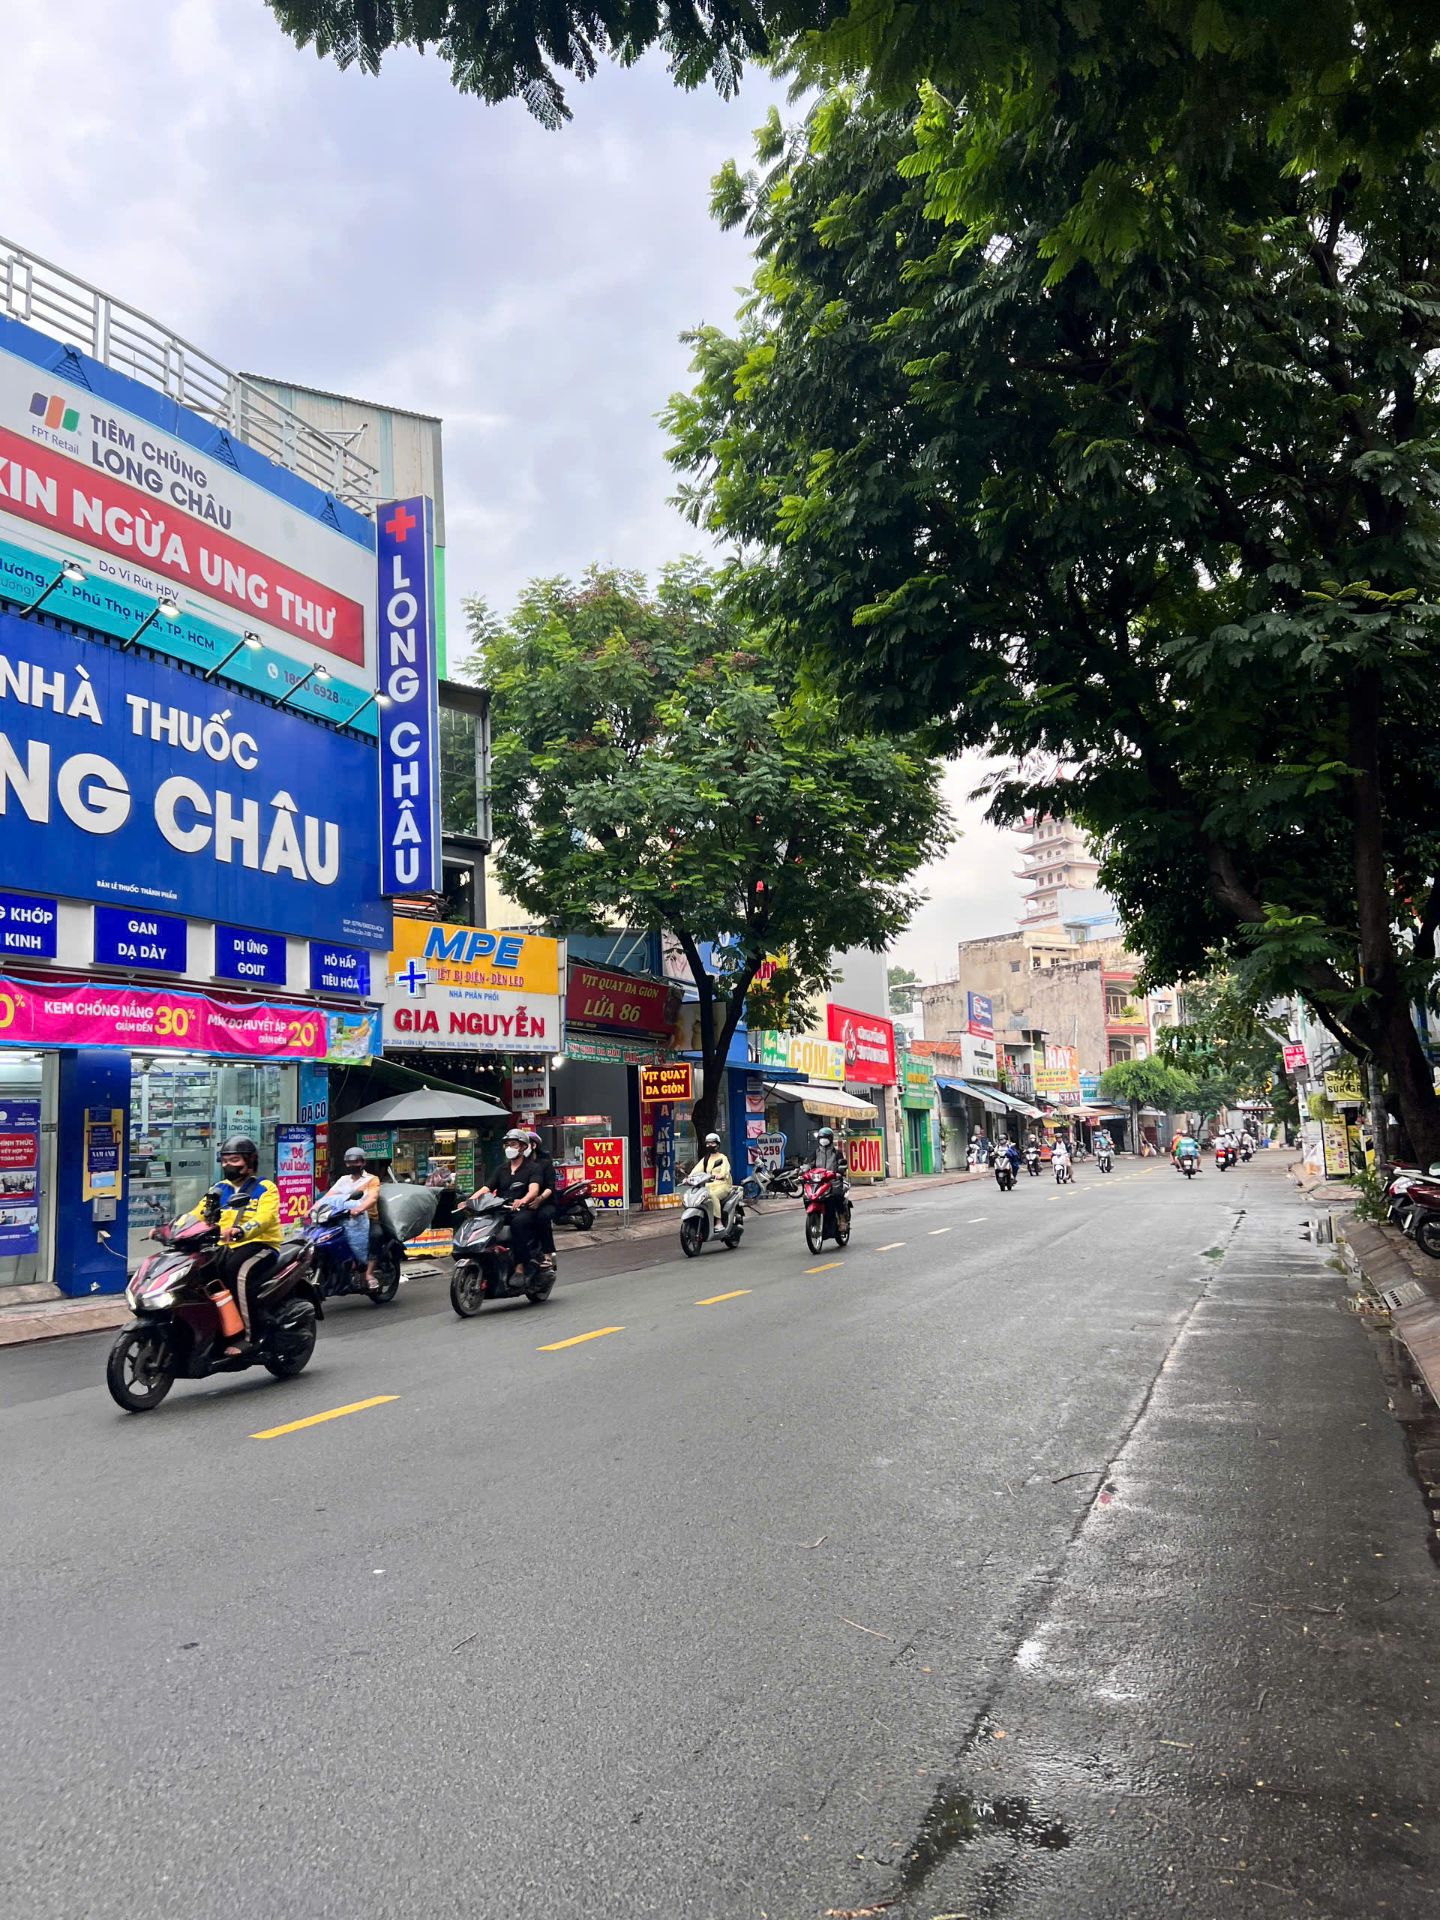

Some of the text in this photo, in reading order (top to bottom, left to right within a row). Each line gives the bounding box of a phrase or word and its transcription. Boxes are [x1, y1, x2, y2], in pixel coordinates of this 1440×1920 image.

[31, 424, 79, 455] FPT Retail
[90, 413, 208, 489] TIÊM CHỦNG
[92, 440, 232, 530] LONG CHÂU
[73, 488, 190, 574] NGỪA
[200, 546, 268, 609] UNG
[275, 585, 336, 640] THƯ
[99, 560, 116, 576] Do
[134, 574, 152, 590] Rút
[156, 583, 179, 600] HPV
[0, 557, 47, 588] ương,
[72, 586, 101, 607] Phú
[104, 597, 131, 621] Thọ
[135, 608, 163, 632] Ha,
[166, 620, 185, 640] TP.
[188, 630, 215, 651] HCM
[386, 554, 420, 703] LONG
[313, 681, 339, 704] 6928
[0, 654, 259, 770] NHÀ THUỐC
[0, 731, 340, 886] NG CHÂU
[389, 721, 422, 884] CHÂU
[118, 883, 139, 893] THUỐC
[11, 907, 53, 925] KHỚP
[128, 920, 158, 935] GAN
[5, 933, 41, 949] KINH
[234, 938, 268, 955] DỊ ỨNG
[423, 925, 525, 969] MPE
[118, 943, 166, 960] DẠ DÀY
[238, 963, 265, 976] GOUT
[324, 954, 356, 969] HÔ HẤP
[322, 974, 359, 989] TIÊU HÓA
[455, 971, 464, 984] BỊ
[465, 971, 485, 987] ĐIỆN
[492, 972, 507, 986] ĐÈN
[509, 975, 524, 987] LED
[582, 973, 659, 999] VỊT QUAY DA GIÒN
[449, 990, 499, 1001] NHÀ PHÂN PHỐI
[583, 994, 641, 1022] LỬA 86
[44, 1000, 74, 1014] KEM
[76, 999, 120, 1017] CHỐNG
[122, 1000, 154, 1018] NẮNG
[154, 1006, 196, 1037] 30%
[243, 1016, 274, 1032] HUYẾT
[275, 1019, 286, 1033] ÁP
[115, 1021, 153, 1032] GIẢM ĐẾN
[394, 1005, 545, 1038] GIA NGUYỄN
[791, 1040, 829, 1075] CƠM
[642, 1070, 687, 1083] VỊT QUAY
[646, 1084, 684, 1095] DA GIÒN
[301, 1097, 326, 1123] ĐÃ CÓ
[593, 1142, 614, 1154] VỊT
[763, 1145, 780, 1156] 259
[849, 1138, 881, 1172] CƠM
[587, 1155, 620, 1167] QUAY
[595, 1170, 612, 1179] DA
[591, 1183, 619, 1193] GIÒN
[608, 1198, 623, 1208] 86
